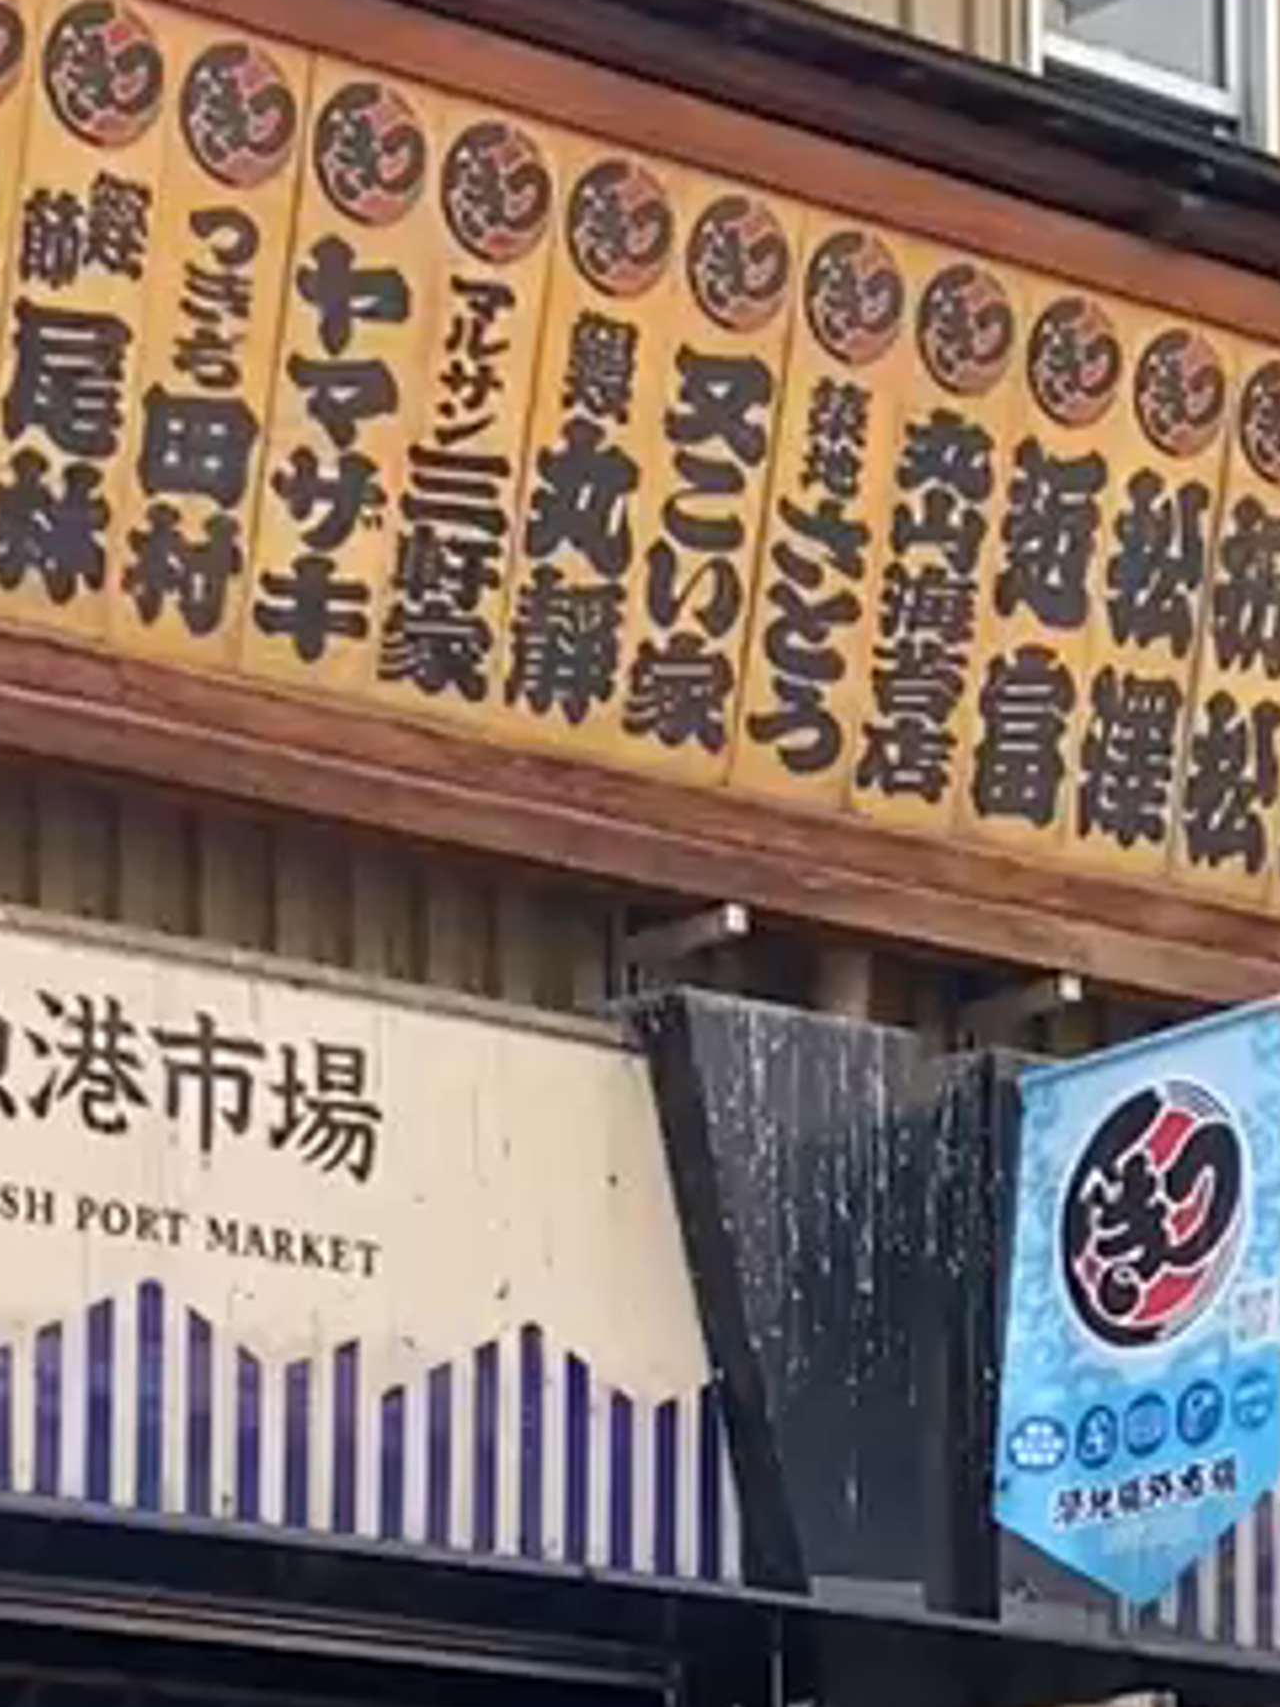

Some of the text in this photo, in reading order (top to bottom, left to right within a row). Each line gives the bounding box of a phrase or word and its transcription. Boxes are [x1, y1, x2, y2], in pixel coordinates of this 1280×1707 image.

[254, 234, 411, 663] ヤマザキ
[75, 1197, 189, 1247] PORT
[206, 1217, 382, 1278] MARKET
